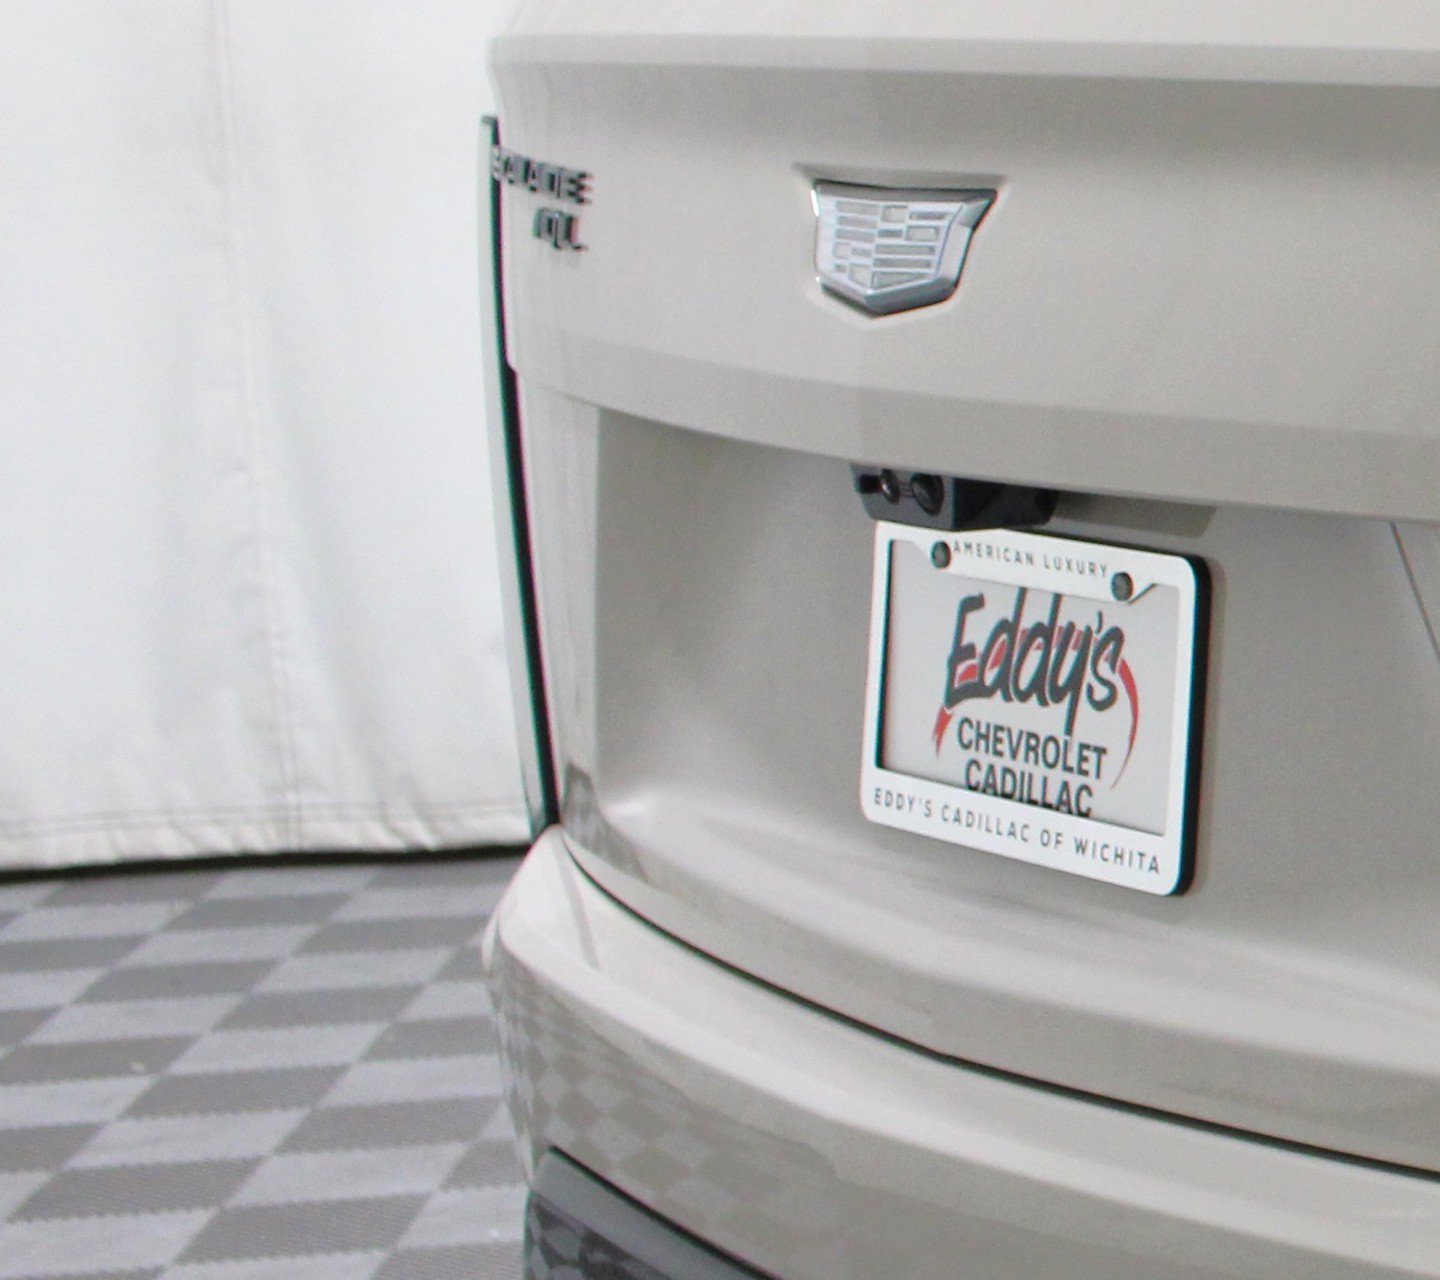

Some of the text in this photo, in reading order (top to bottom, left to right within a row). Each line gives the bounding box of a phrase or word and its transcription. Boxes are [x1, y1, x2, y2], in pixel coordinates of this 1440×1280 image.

[952, 541, 1110, 578] AMERICAN LUXURY
[944, 587, 1126, 736] Eddy's
[956, 717, 1107, 781] CHEVROLET
[964, 758, 1094, 818] CADILLAC
[873, 786, 1161, 875] EDDY'S CADILLAC OF WICHITA
